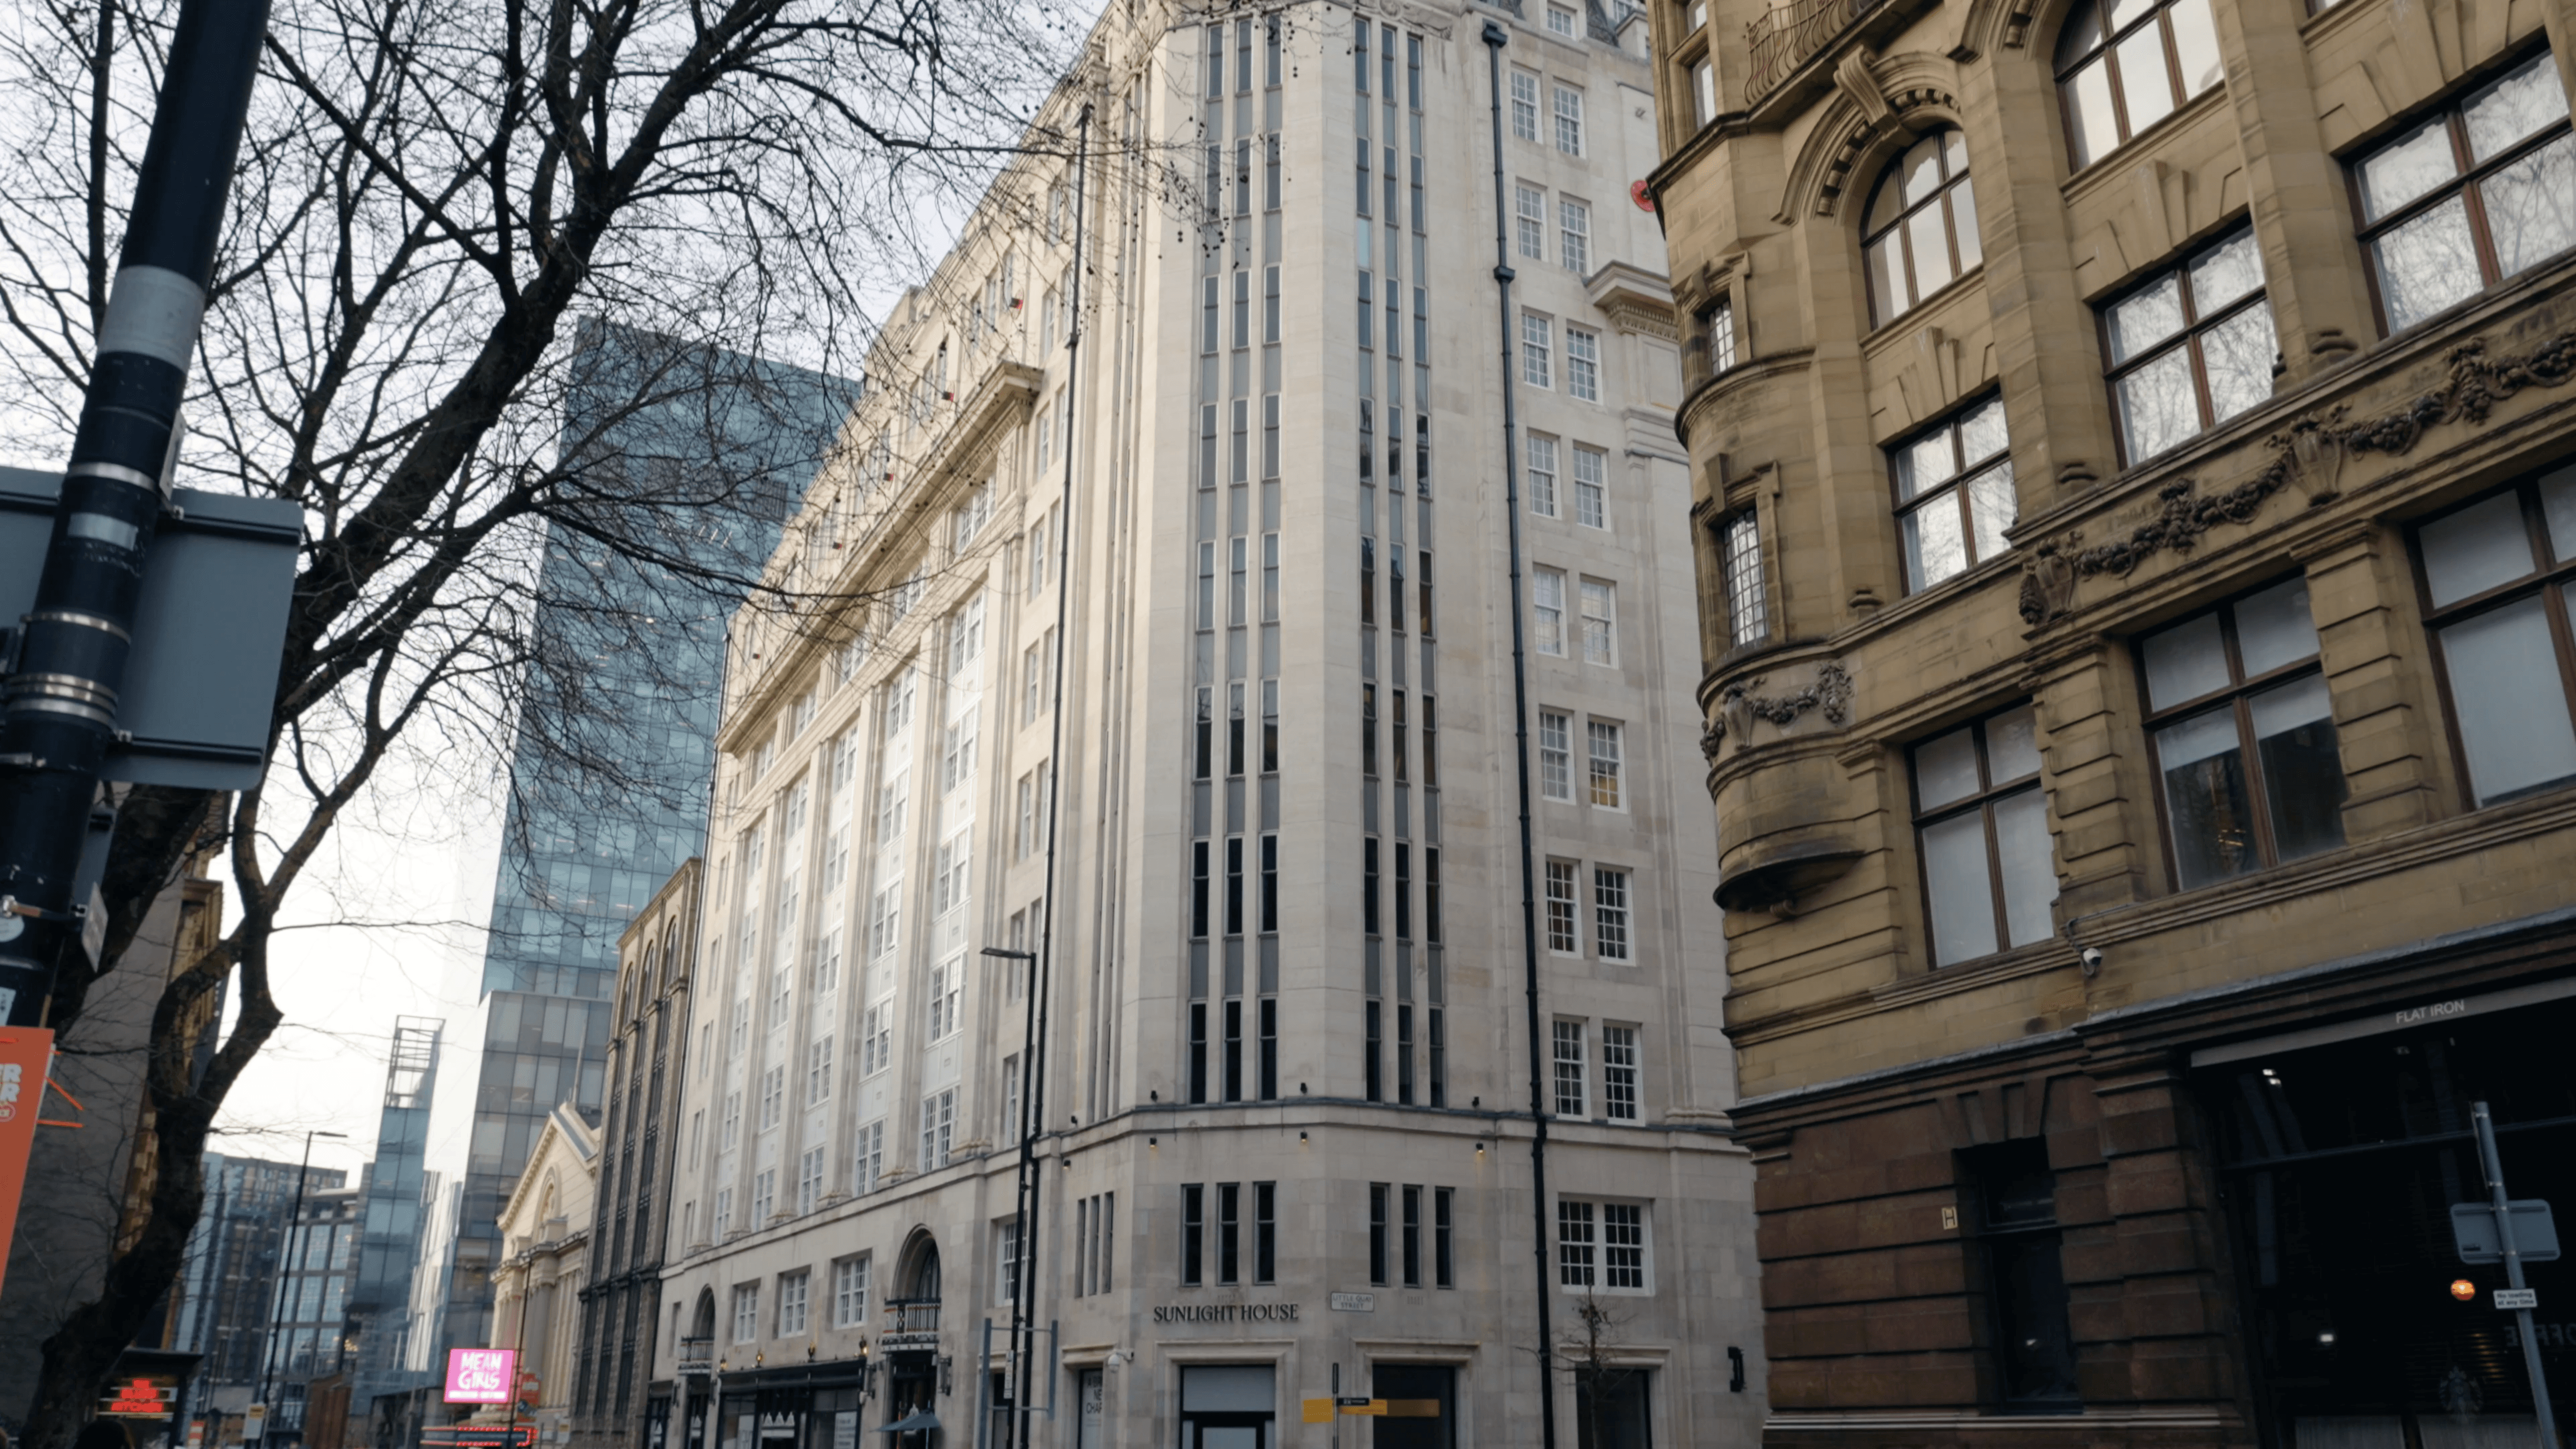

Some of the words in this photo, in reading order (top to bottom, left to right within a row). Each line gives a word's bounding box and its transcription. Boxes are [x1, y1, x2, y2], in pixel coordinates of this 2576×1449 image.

[2395, 1007, 2427, 1024] FLAT
[2430, 999, 2465, 1016] IRON
[1154, 1305, 1237, 1322] SUNLIGHT
[1241, 1304, 1299, 1321] HOUSE
[461, 1352, 503, 1370] MEAN
[458, 1371, 500, 1390] GIRLS
